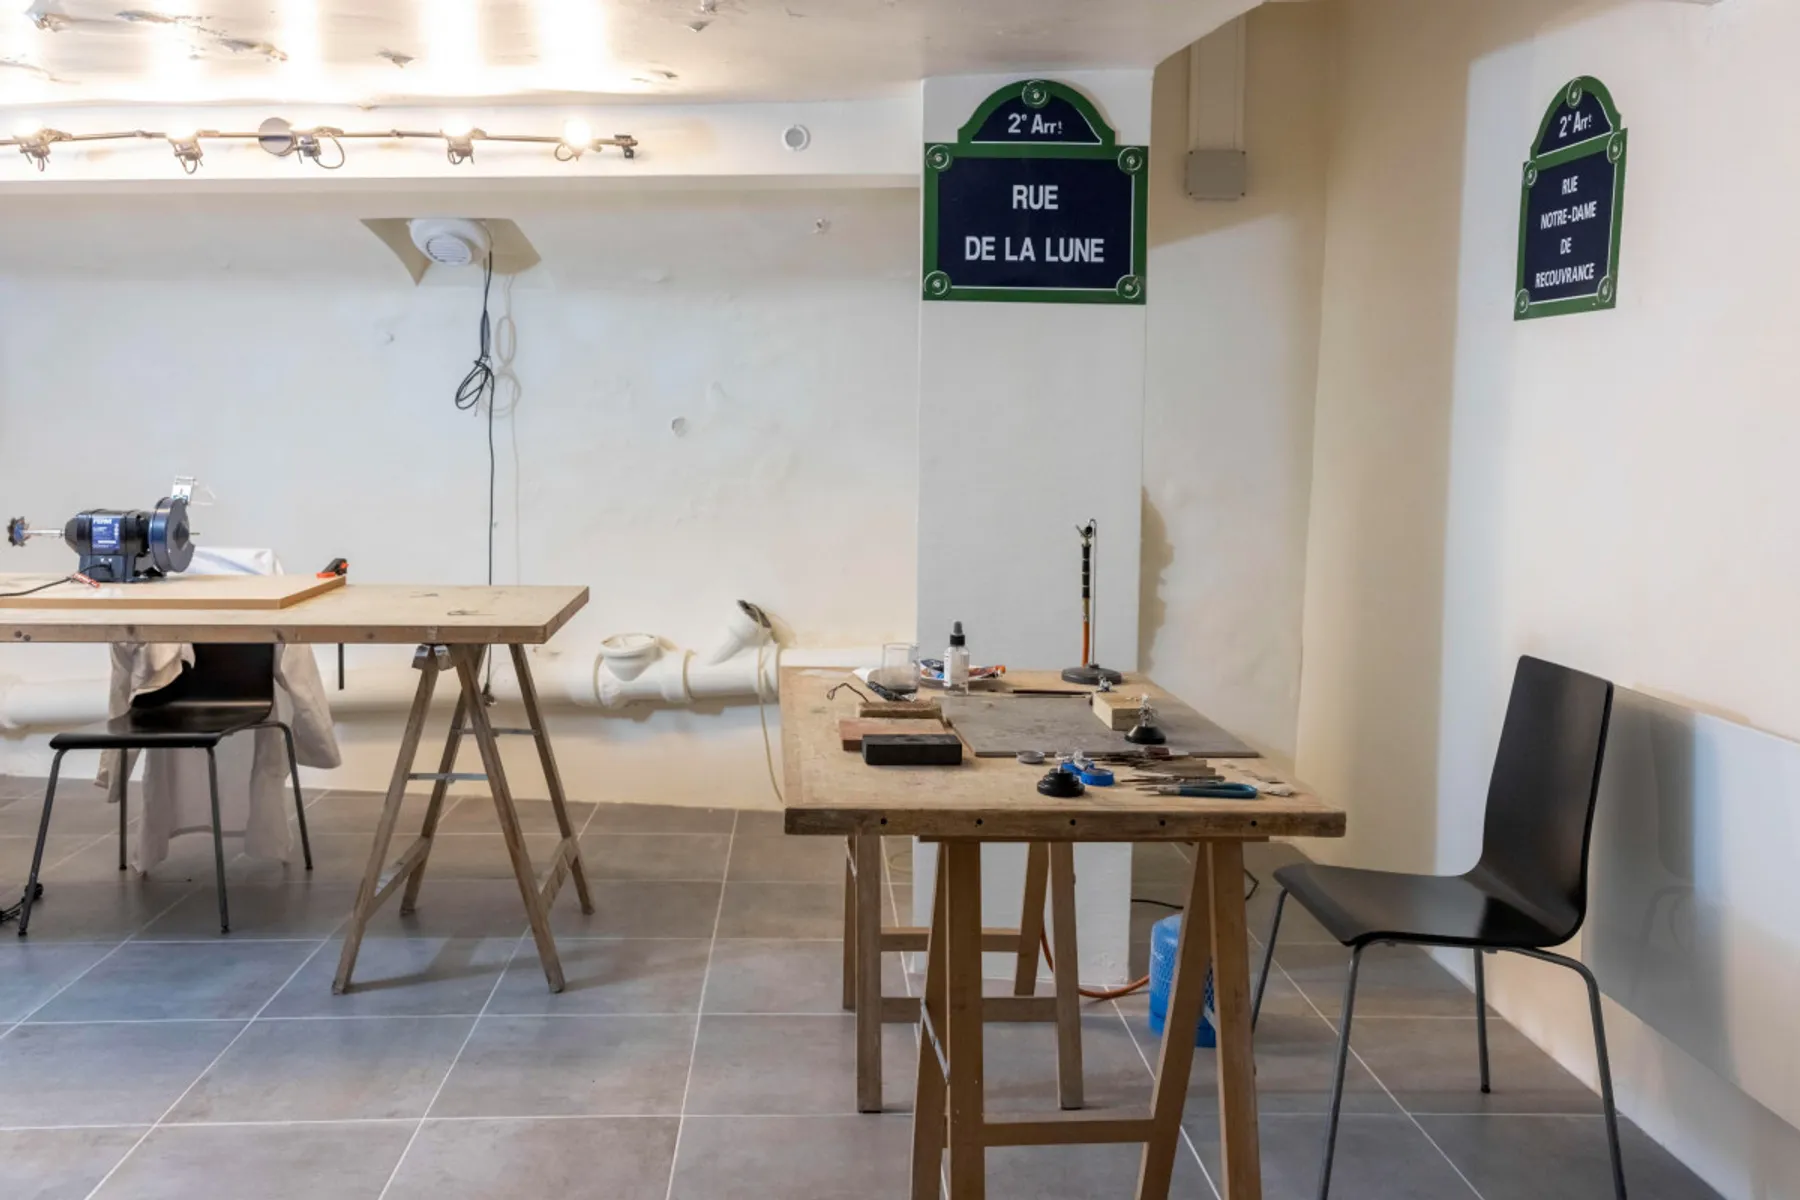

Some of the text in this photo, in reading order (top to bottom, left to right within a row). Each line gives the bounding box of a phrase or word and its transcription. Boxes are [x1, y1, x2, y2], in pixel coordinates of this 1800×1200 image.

[1012, 184, 1059, 210] RUE
[1561, 176, 1578, 195] RUE
[1540, 201, 1597, 230] NOTRE-DAME
[965, 236, 1104, 262] DE LA LUNE
[1560, 237, 1572, 255] DE
[1535, 263, 1595, 288] RECOUVRANCE
